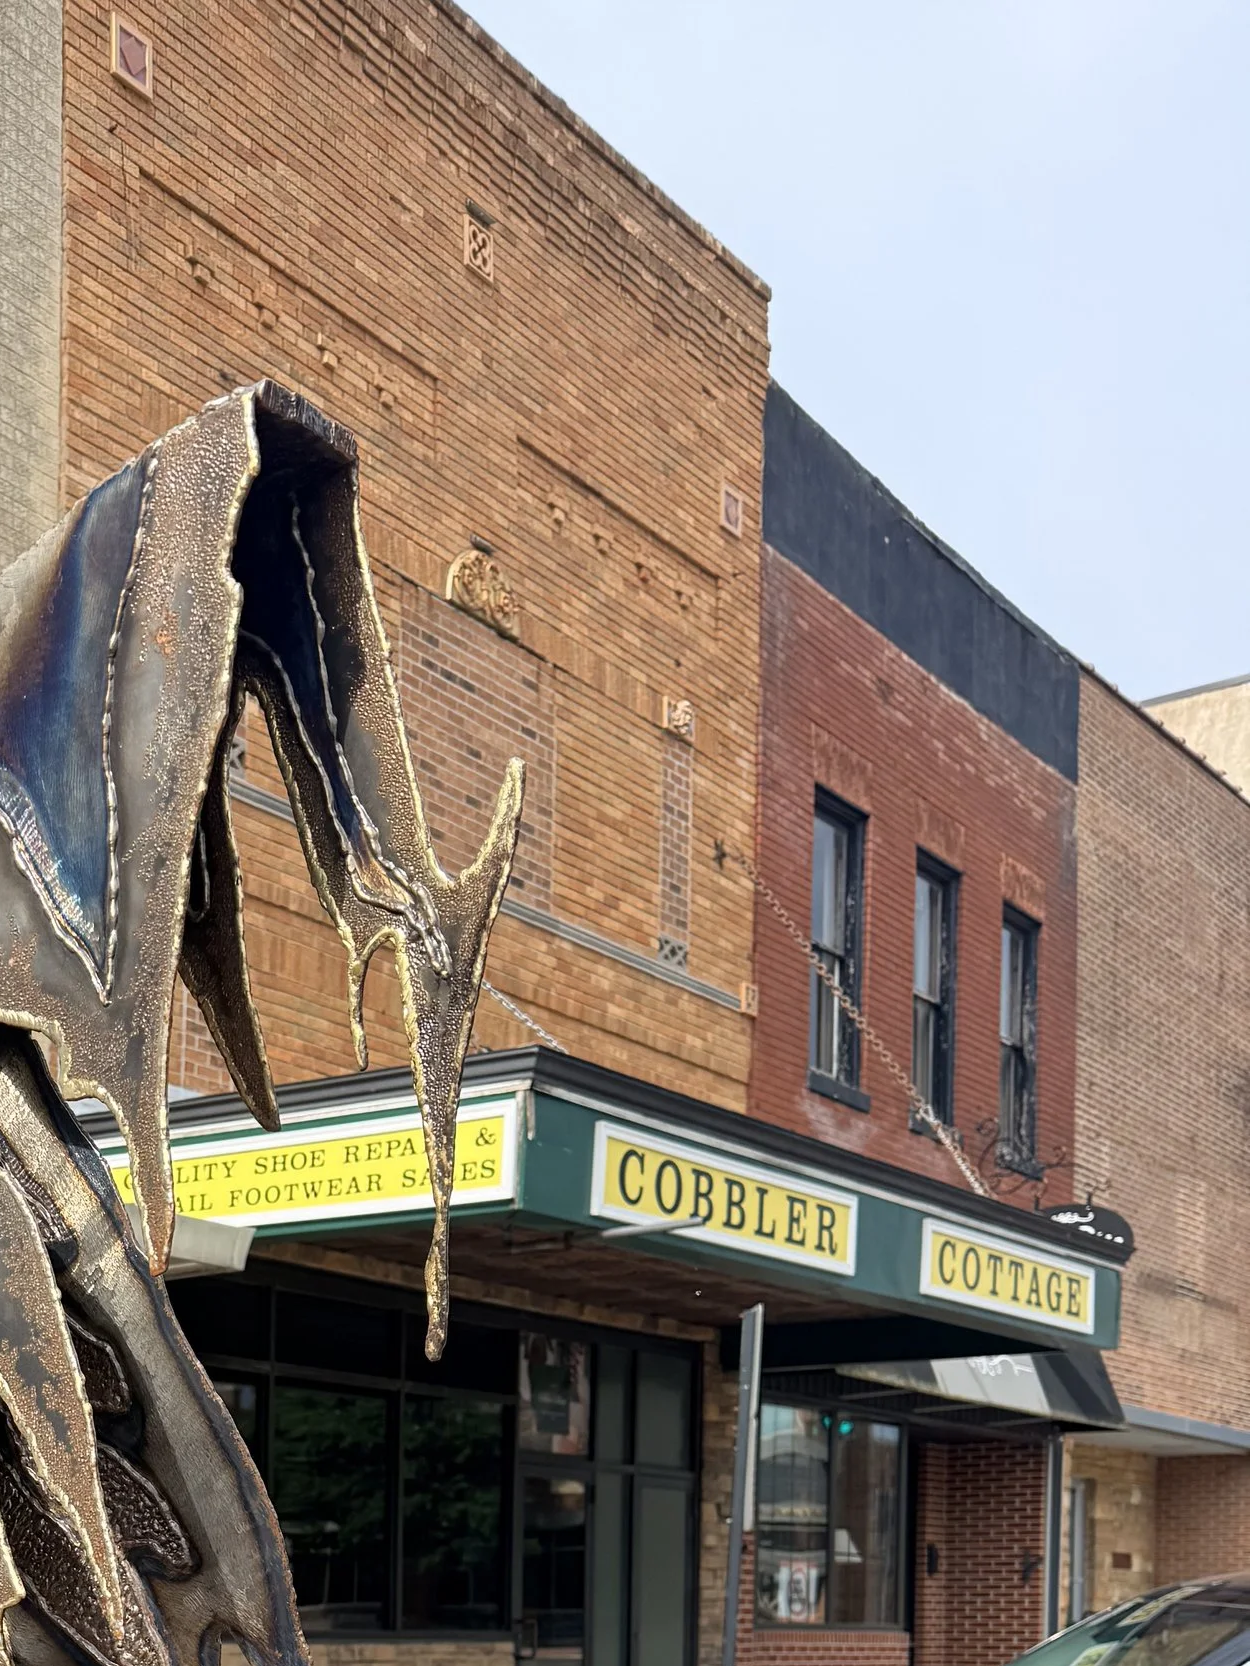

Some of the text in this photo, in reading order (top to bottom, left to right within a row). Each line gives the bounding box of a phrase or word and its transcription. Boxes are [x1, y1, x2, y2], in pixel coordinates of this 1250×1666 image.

[229, 1173, 382, 1208] FOOTWEAR
[402, 1159, 496, 1188] SAES
[254, 1149, 325, 1175] SHOE
[475, 1127, 496, 1148] &
[617, 1148, 840, 1258] COBBLER
[938, 1238, 1082, 1319] COTTAGE
